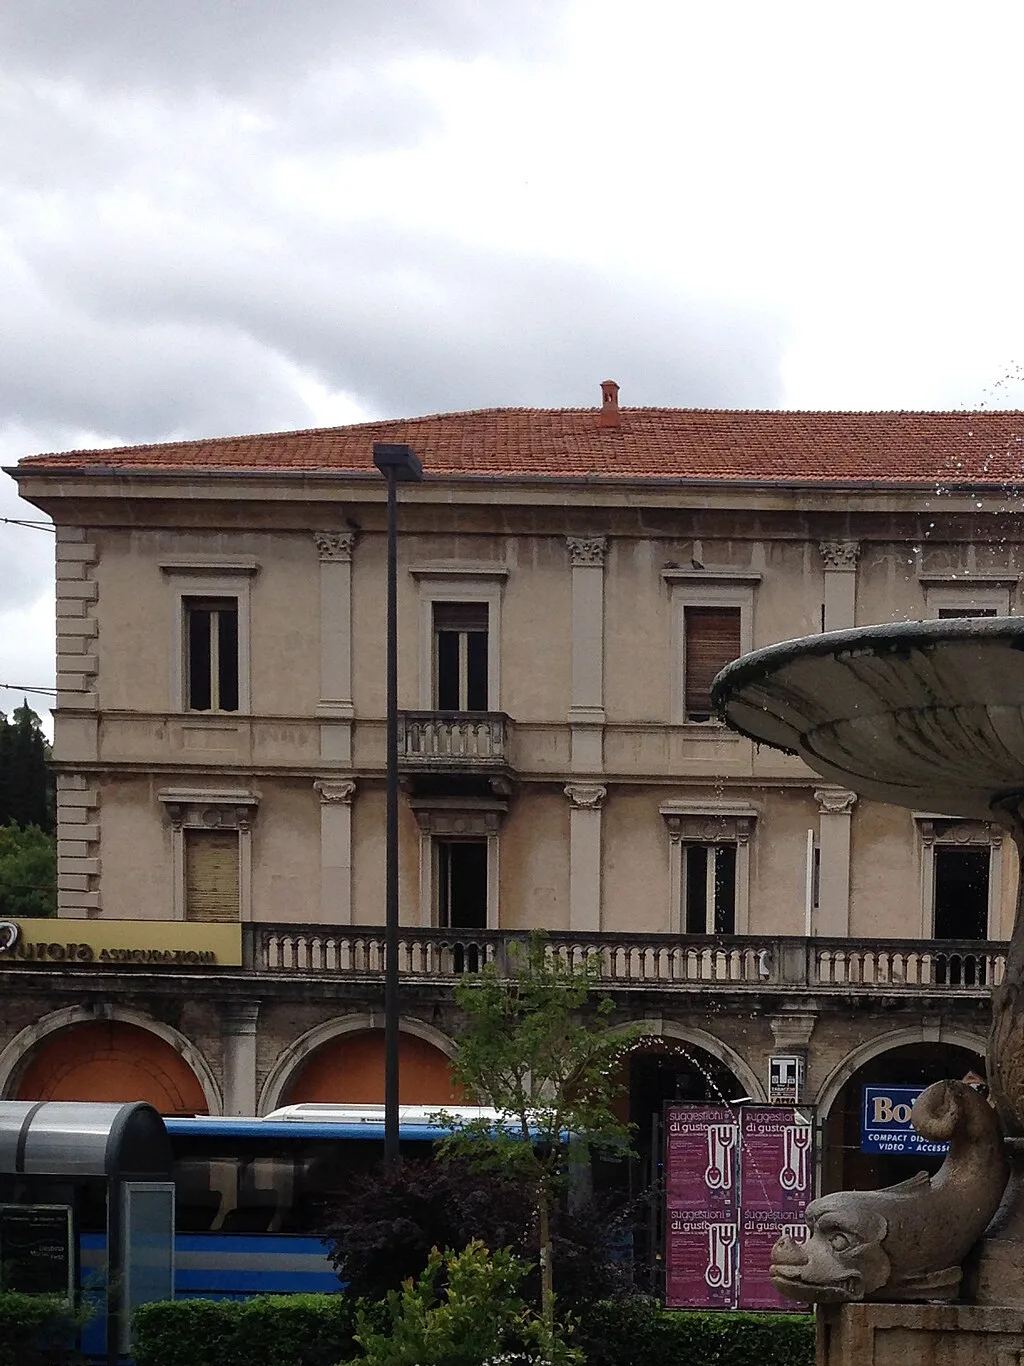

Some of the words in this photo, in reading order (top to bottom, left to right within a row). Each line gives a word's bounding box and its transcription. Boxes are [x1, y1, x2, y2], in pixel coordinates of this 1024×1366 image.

[10, 943, 95, 961] urora
[772, 1060, 795, 1083] T
[669, 1110, 723, 1122] suggestioni
[669, 1122, 680, 1132] di
[681, 1123, 709, 1134] gusto
[745, 1123, 756, 1132] di
[758, 1124, 787, 1135] gusto
[868, 1133, 907, 1142] COMPACT
[911, 1135, 929, 1143] DIS
[879, 1143, 905, 1151] VIDEO
[916, 1144, 950, 1152] ACCESS
[671, 1209, 725, 1221] suggestioni
[671, 1221, 681, 1230] di
[683, 1221, 711, 1232] gusto
[744, 1221, 754, 1230] di
[756, 1222, 784, 1233] gusto
